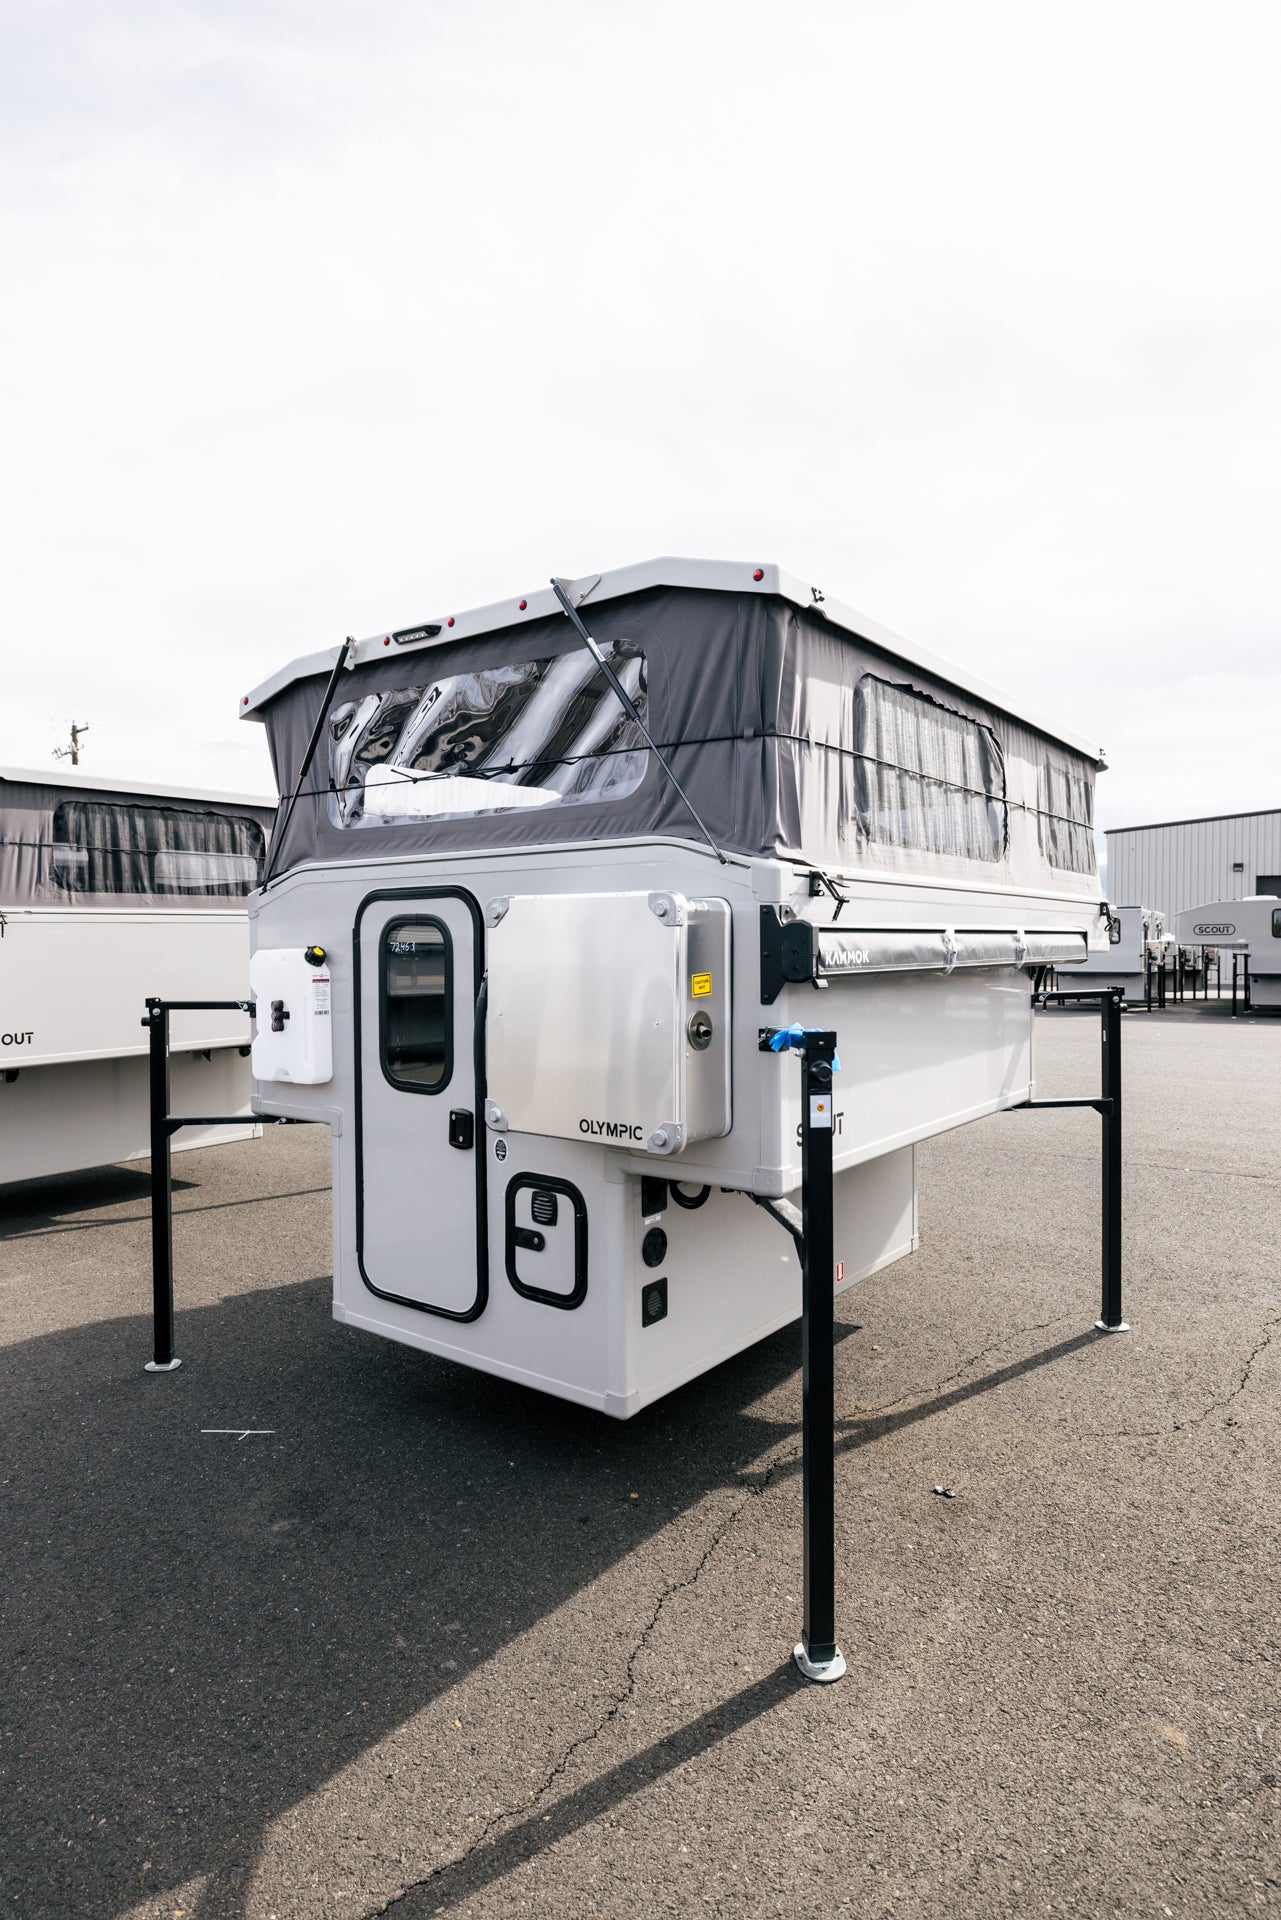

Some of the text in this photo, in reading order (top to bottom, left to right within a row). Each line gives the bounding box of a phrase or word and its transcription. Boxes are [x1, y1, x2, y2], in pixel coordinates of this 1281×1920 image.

[1198, 926, 1230, 934] SCOUT
[825, 950, 869, 965] KAMMOK
[579, 1118, 643, 1141] OLYMPIC
